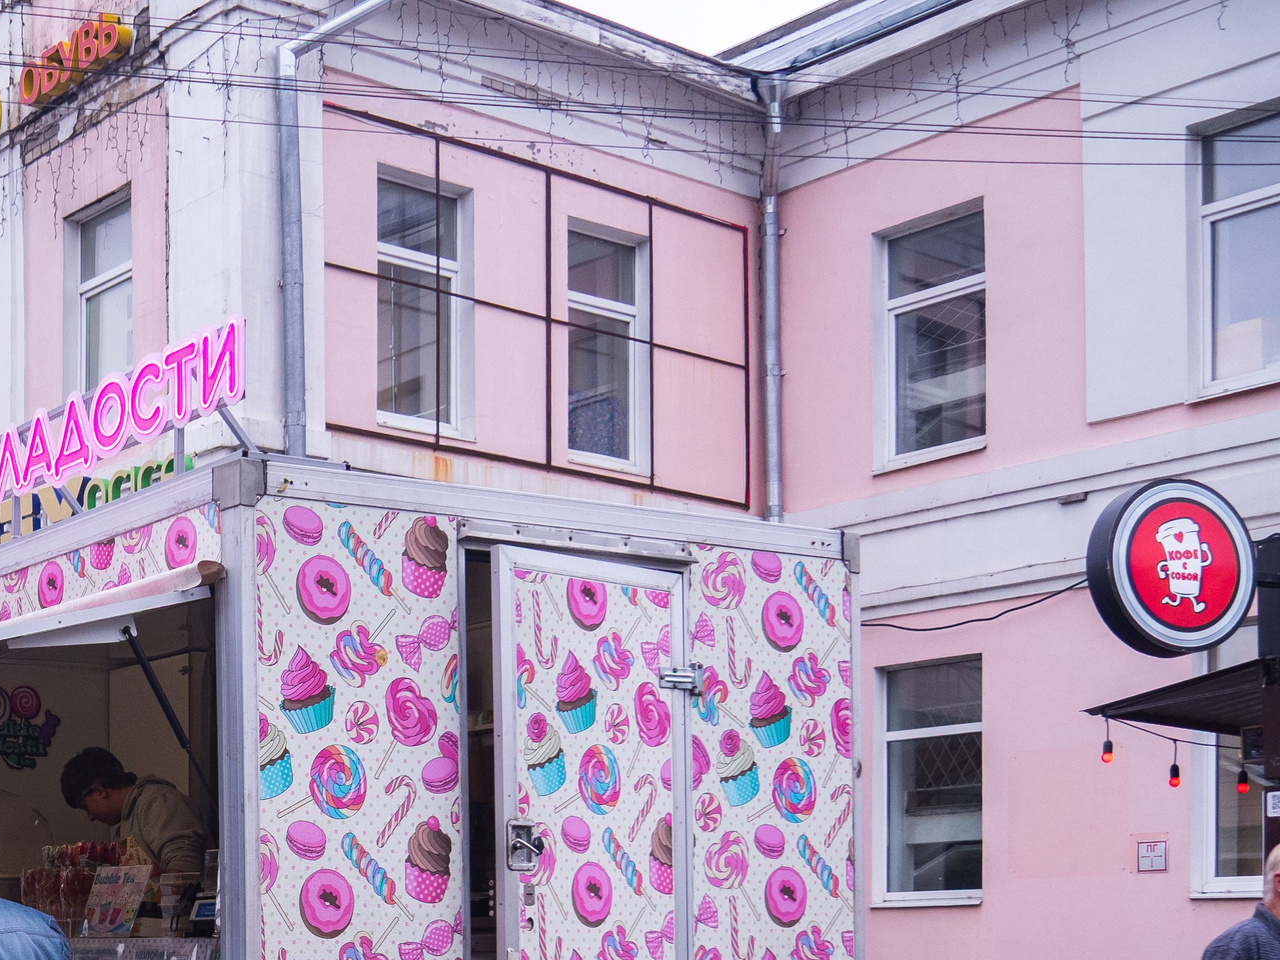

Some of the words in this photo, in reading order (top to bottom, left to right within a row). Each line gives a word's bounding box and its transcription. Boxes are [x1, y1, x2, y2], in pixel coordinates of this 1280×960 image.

[19, 13, 126, 105] ОБУВЬ
[1167, 549, 1199, 562] КОФЕ
[1170, 570, 1199, 583] СОБОЙ
[1146, 844, 1159, 854] ПГ
[94, 873, 120, 885] Bubble
[122, 872, 136, 884] Tea
